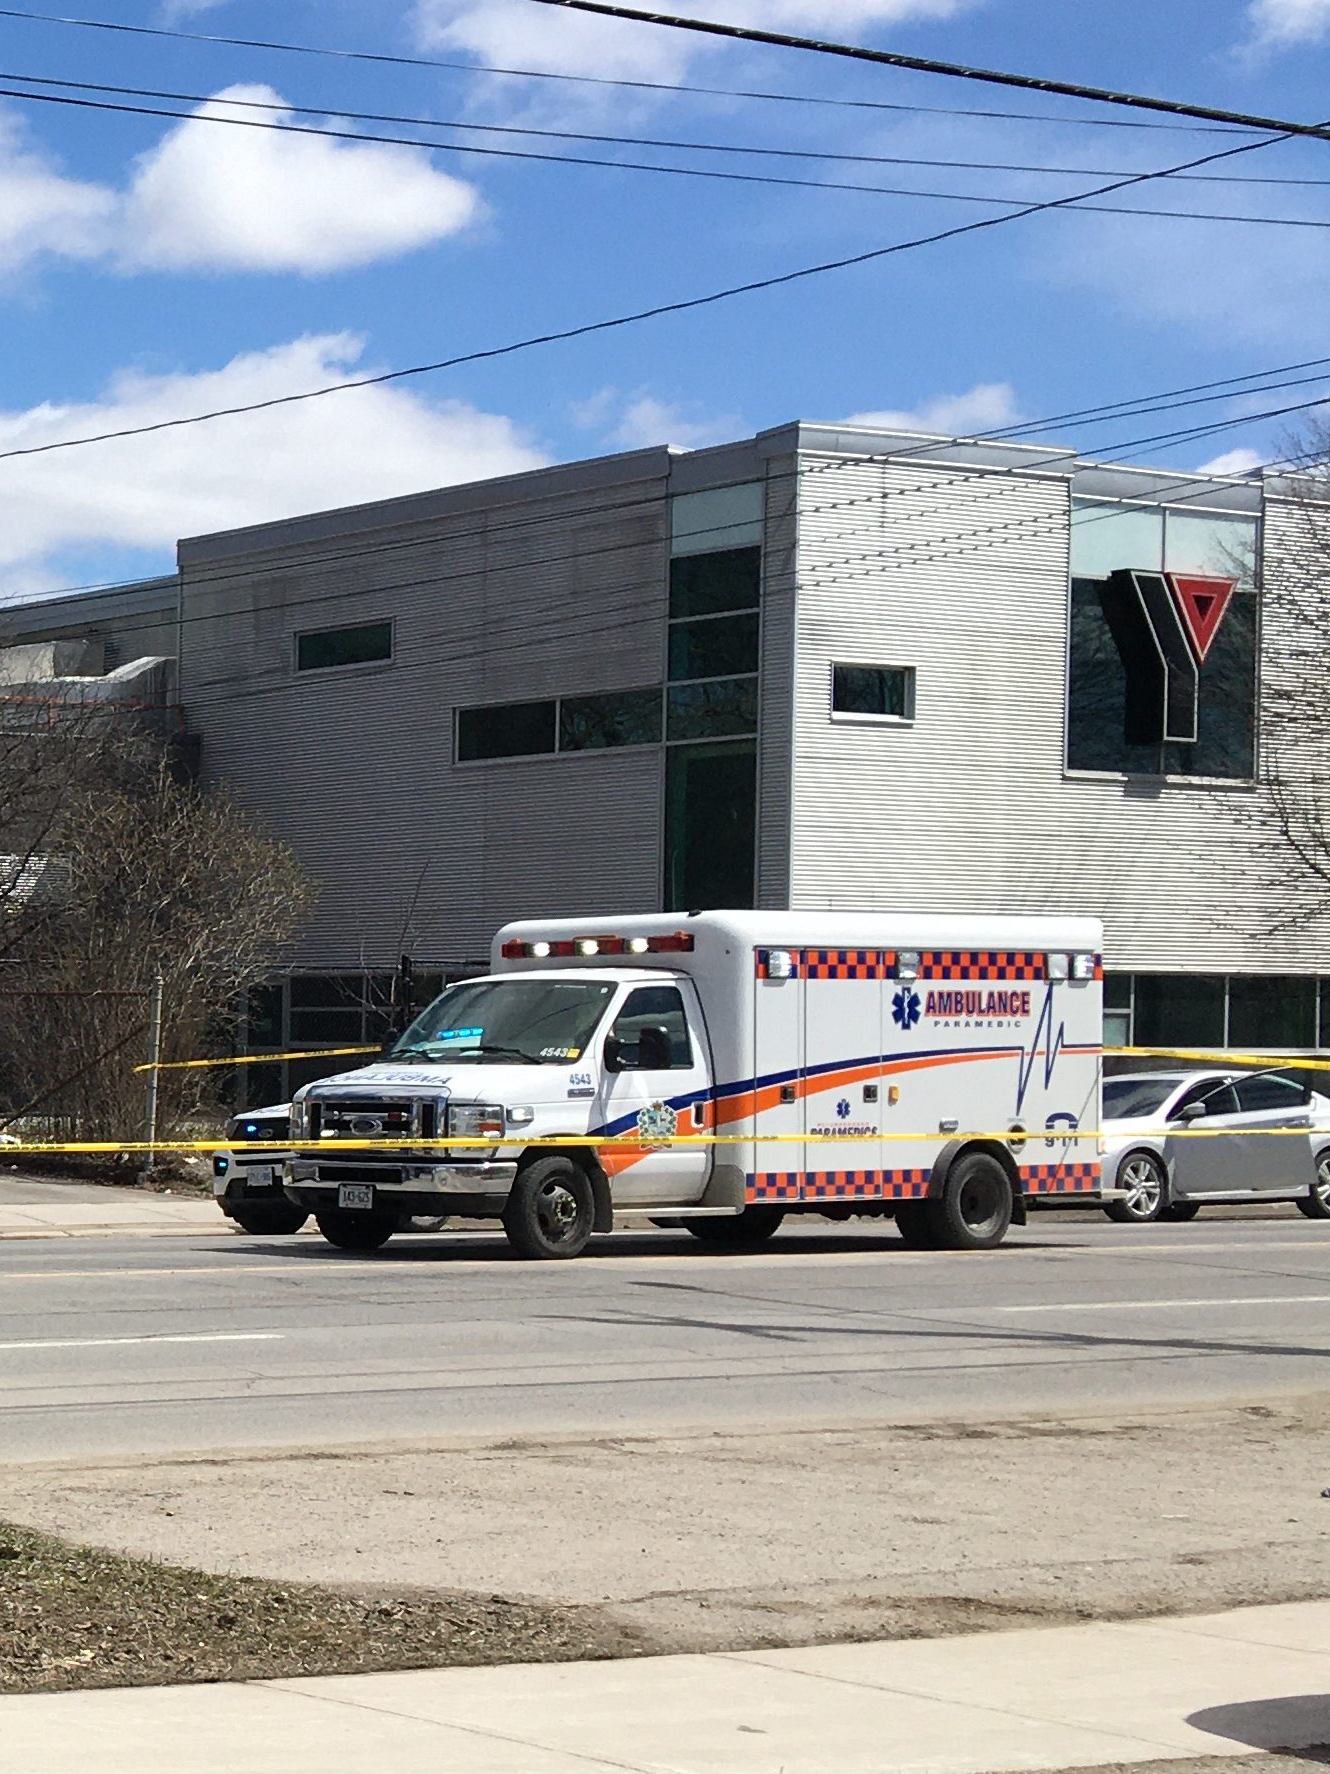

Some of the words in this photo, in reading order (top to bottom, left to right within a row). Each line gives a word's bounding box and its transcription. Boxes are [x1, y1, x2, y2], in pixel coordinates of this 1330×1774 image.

[924, 989, 1031, 1017] AMBULANCE
[933, 1020, 1022, 1028] PARAMEDIC
[539, 1047, 569, 1058] 4543
[569, 1073, 592, 1085] 4543
